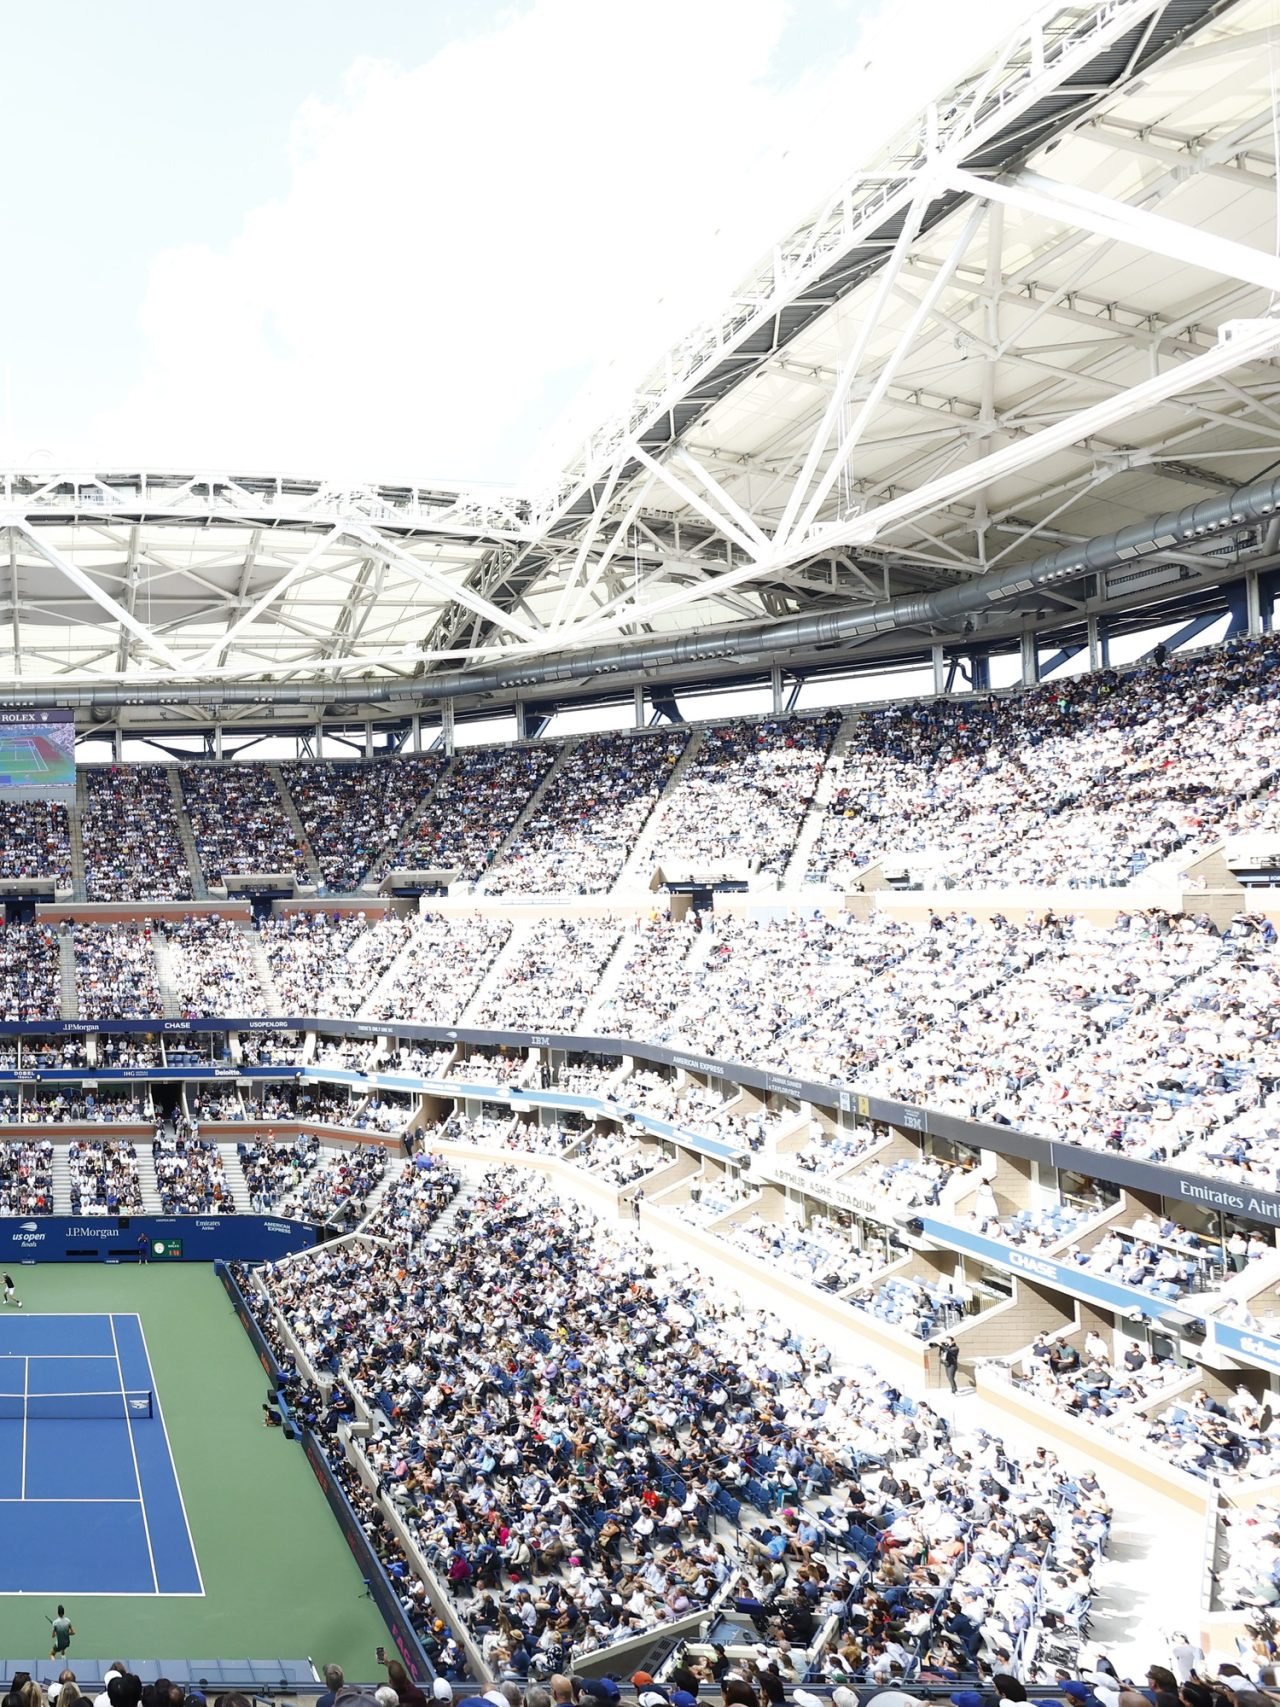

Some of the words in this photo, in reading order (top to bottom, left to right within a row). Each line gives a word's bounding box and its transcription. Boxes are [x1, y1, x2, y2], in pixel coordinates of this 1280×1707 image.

[2, 714, 36, 722] ROLEX
[63, 1024, 99, 1032] J.P.Morgan
[532, 1036, 550, 1045] IBM
[673, 1056, 699, 1068] AMERICAN
[699, 1062, 724, 1075] EXPRESS
[904, 1115, 922, 1130] IBM
[774, 1169, 805, 1187] ARTHUR
[809, 1182, 832, 1198] ASHE
[835, 1191, 876, 1212] STADIUM
[1180, 1180, 1244, 1209] Emirates
[263, 1221, 290, 1230] AMERICAN
[267, 1226, 291, 1234] EXPRESS
[12, 1233, 23, 1241] us
[23, 1233, 45, 1242] open
[65, 1228, 119, 1239] J.P.Morgan
[1009, 1251, 1058, 1281] CHASE
